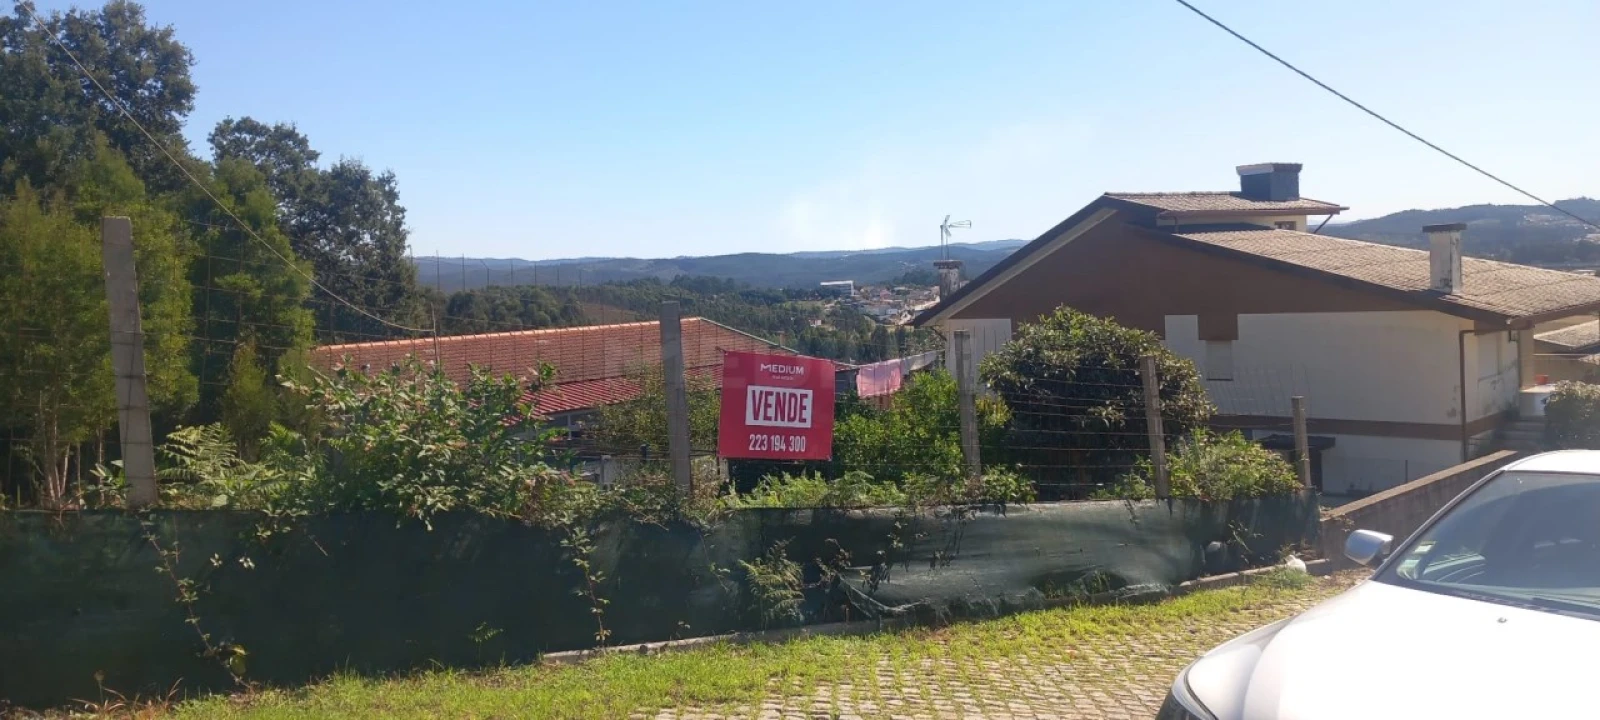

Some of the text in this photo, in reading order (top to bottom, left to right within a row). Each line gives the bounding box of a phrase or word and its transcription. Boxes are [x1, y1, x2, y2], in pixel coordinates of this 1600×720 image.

[760, 363, 805, 375] MEDIUM
[751, 389, 809, 423] VENDE
[748, 434, 806, 452] 223 194 300
